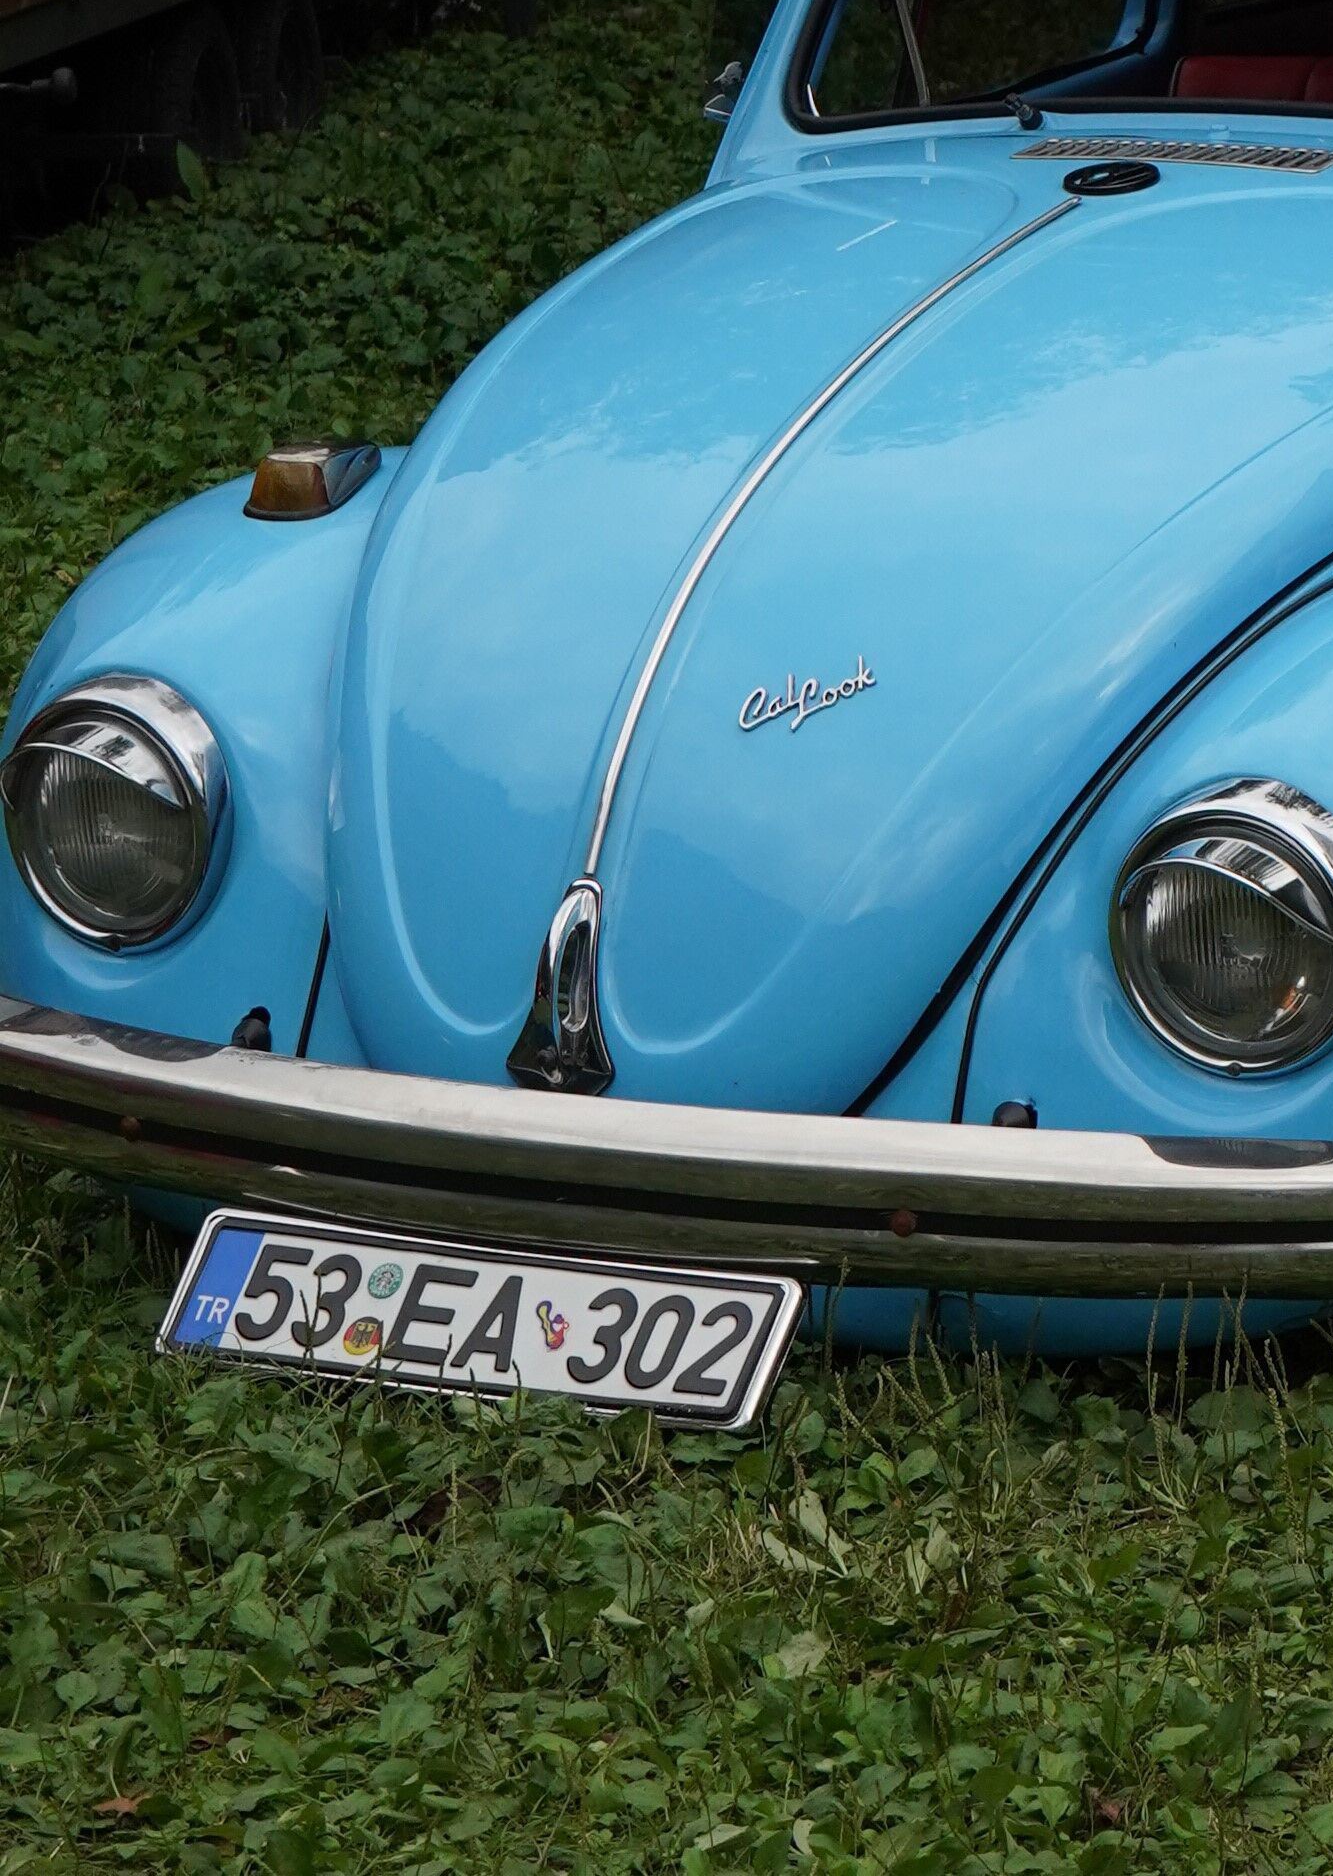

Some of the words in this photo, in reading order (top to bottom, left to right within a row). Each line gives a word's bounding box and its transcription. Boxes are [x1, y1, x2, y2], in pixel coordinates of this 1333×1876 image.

[194, 1294, 230, 1324] TR
[234, 1243, 362, 1348] 53
[382, 1263, 524, 1375] EA
[567, 1287, 754, 1397] 302
